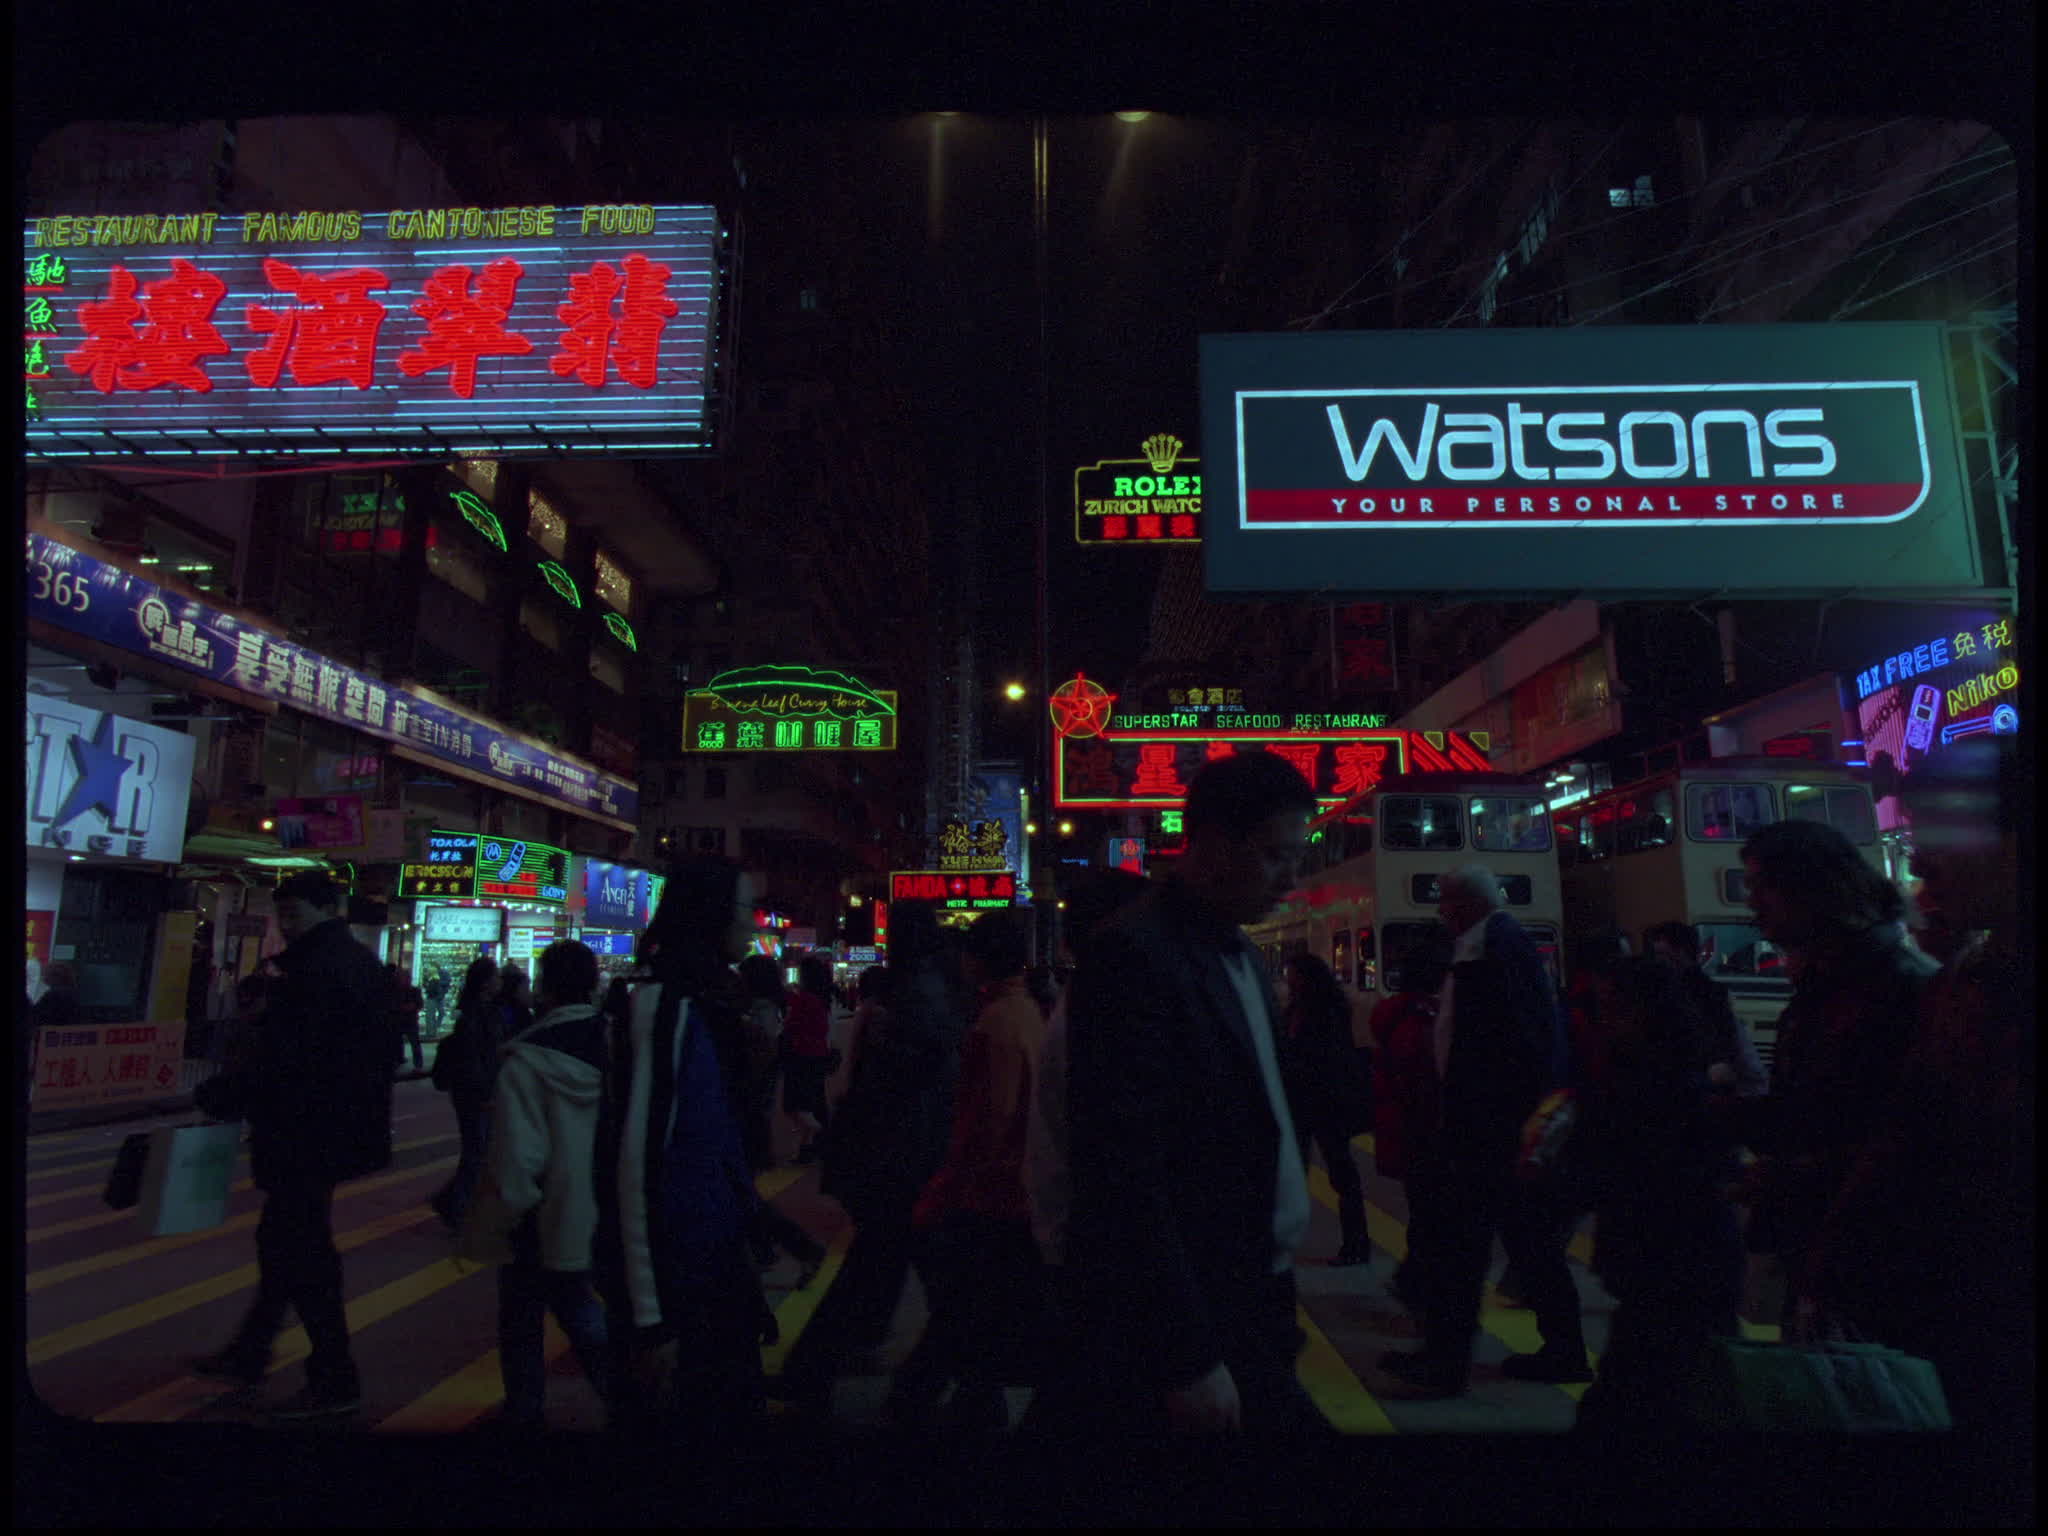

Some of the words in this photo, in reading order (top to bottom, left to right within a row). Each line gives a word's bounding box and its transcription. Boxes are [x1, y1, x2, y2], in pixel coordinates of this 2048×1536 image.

[35, 213, 217, 247] RESTAURANT
[243, 211, 361, 243] FAMOUS
[388, 205, 554, 239] CANTONESE
[581, 204, 655, 235] FOOD
[1326, 403, 1837, 481] Watsons
[1084, 500, 1148, 515] ZURICH
[1332, 498, 1434, 513] YOUR
[1467, 495, 1681, 513] PERSONAL
[1715, 494, 1845, 510] STORE
[1857, 665, 1882, 698] TAX
[1884, 637, 1949, 685] FREE
[1114, 713, 1198, 729] SUPERSTAR
[1216, 713, 1281, 729] SEAFOOD
[1295, 713, 1386, 728] RESTAURANT
